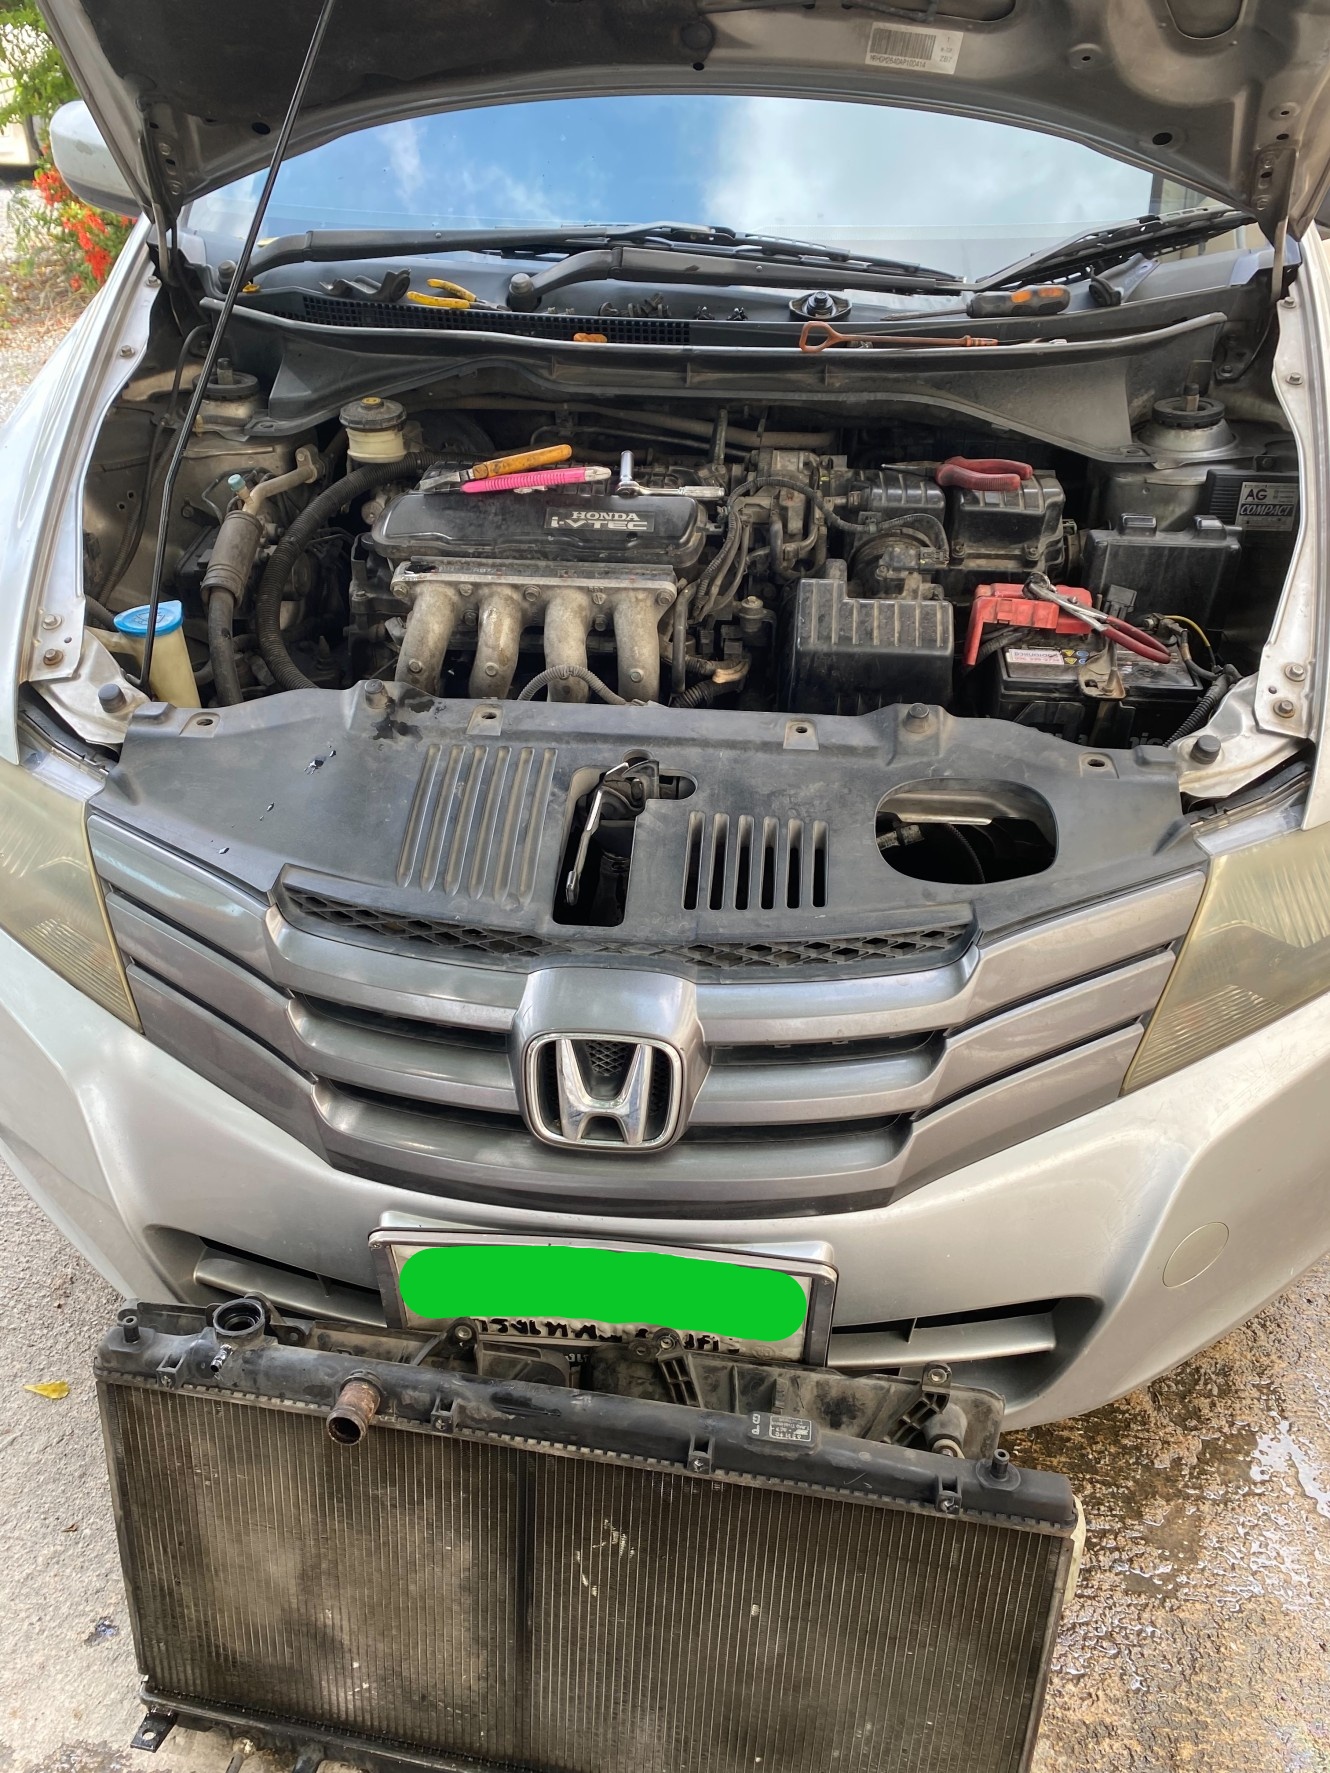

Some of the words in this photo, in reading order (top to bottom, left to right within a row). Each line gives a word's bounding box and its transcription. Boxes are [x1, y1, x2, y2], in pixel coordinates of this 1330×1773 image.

[1244, 488, 1268, 501] AG
[571, 511, 641, 521] HONDA
[1240, 504, 1294, 516] COMPACT
[550, 516, 648, 530] i-VTEC
